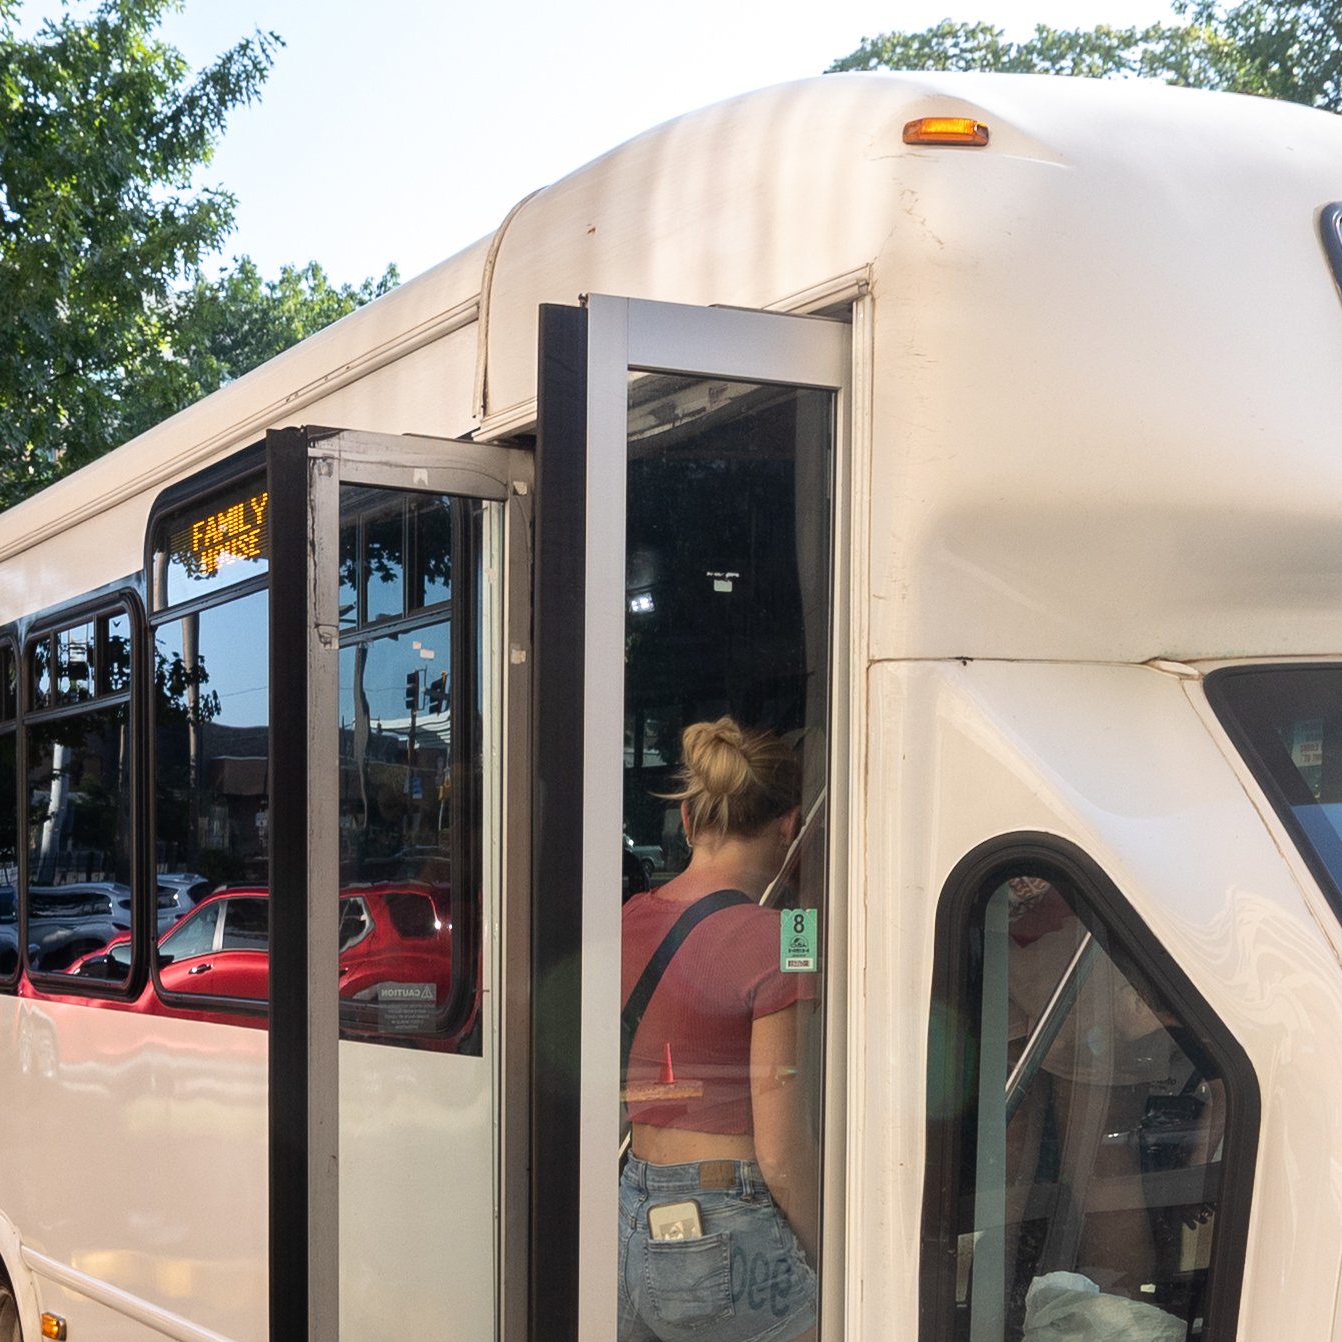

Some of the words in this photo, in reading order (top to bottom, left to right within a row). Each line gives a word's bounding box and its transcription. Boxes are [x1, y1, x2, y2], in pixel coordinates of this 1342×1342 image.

[192, 492, 269, 552] FAMILY
[200, 528, 261, 574] HOUSE
[793, 914, 805, 934] 8
